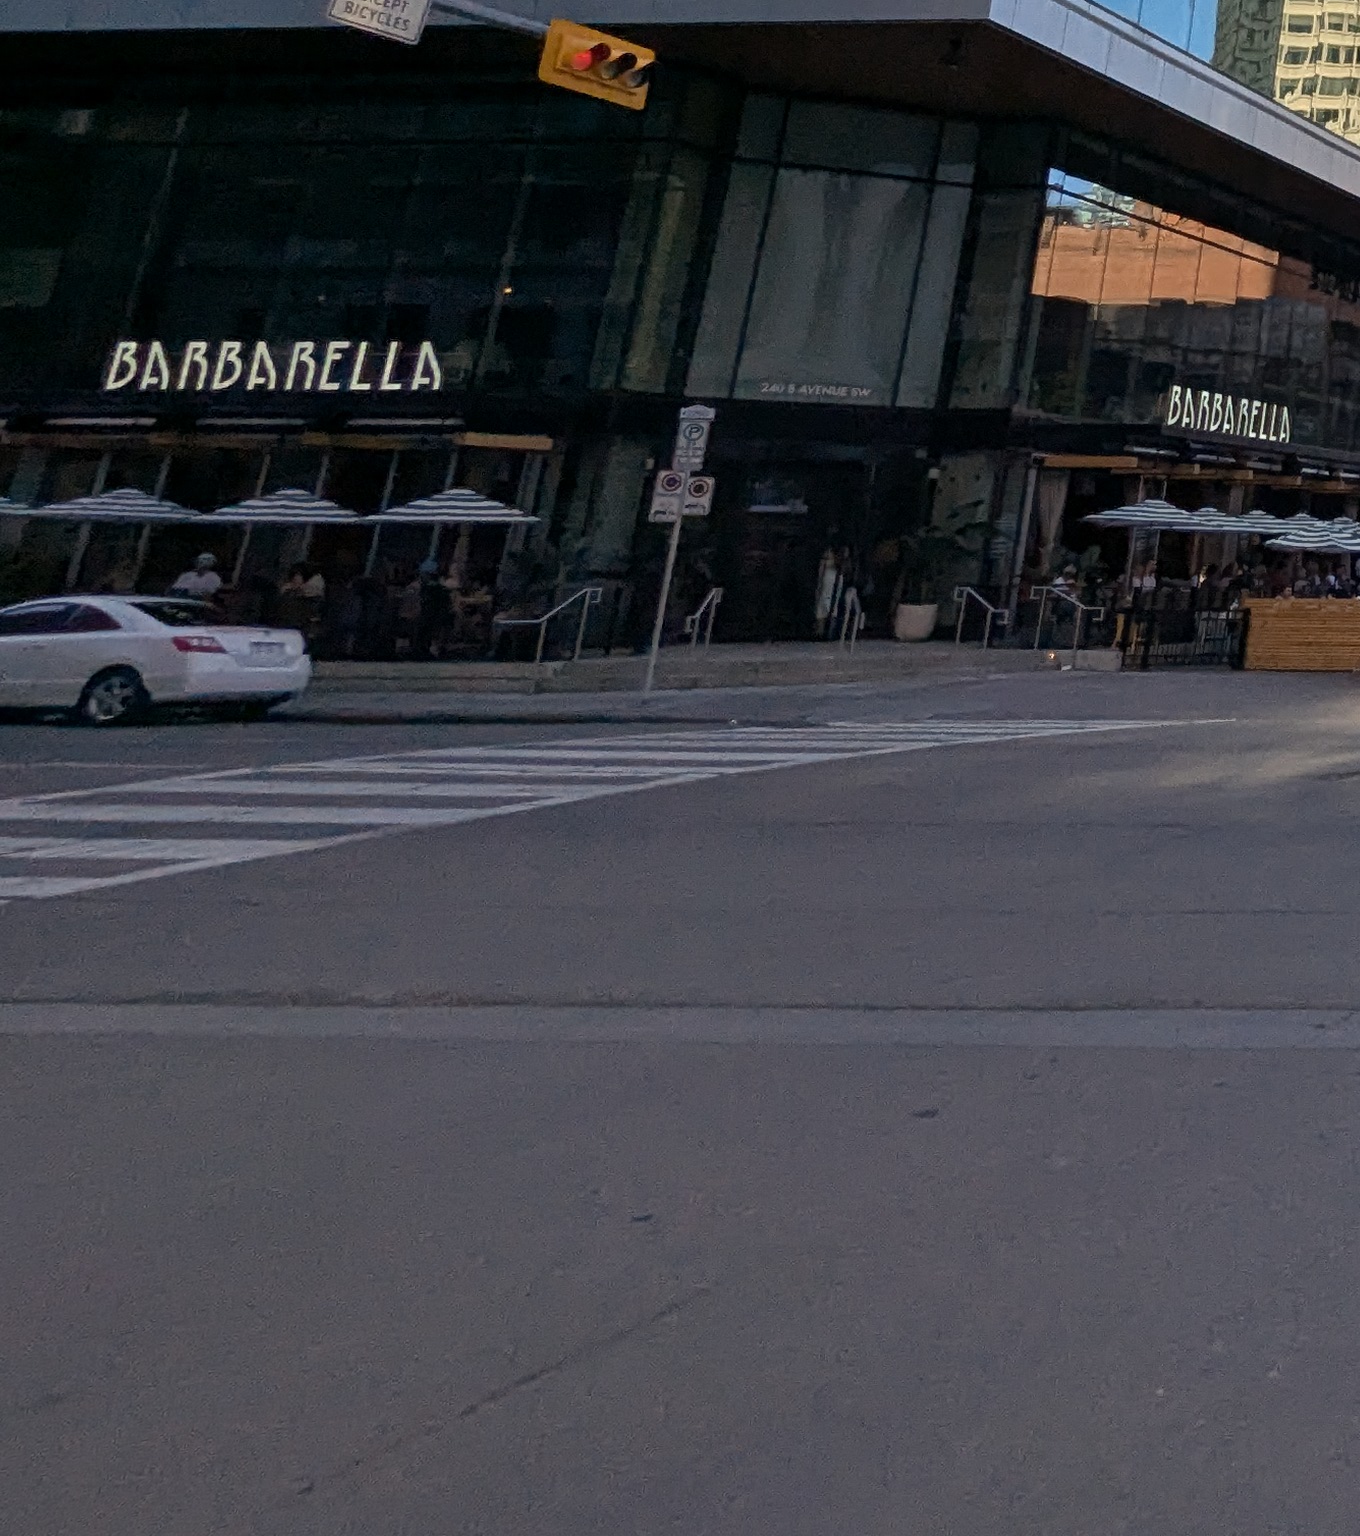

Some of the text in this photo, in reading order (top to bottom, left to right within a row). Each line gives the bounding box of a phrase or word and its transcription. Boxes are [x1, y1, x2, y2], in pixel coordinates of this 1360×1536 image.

[344, 1, 411, 31] BICYCLES
[105, 341, 442, 391] BARBARELLA
[798, 384, 849, 397] AVENUE
[1167, 385, 1290, 443] BARBARELLA
